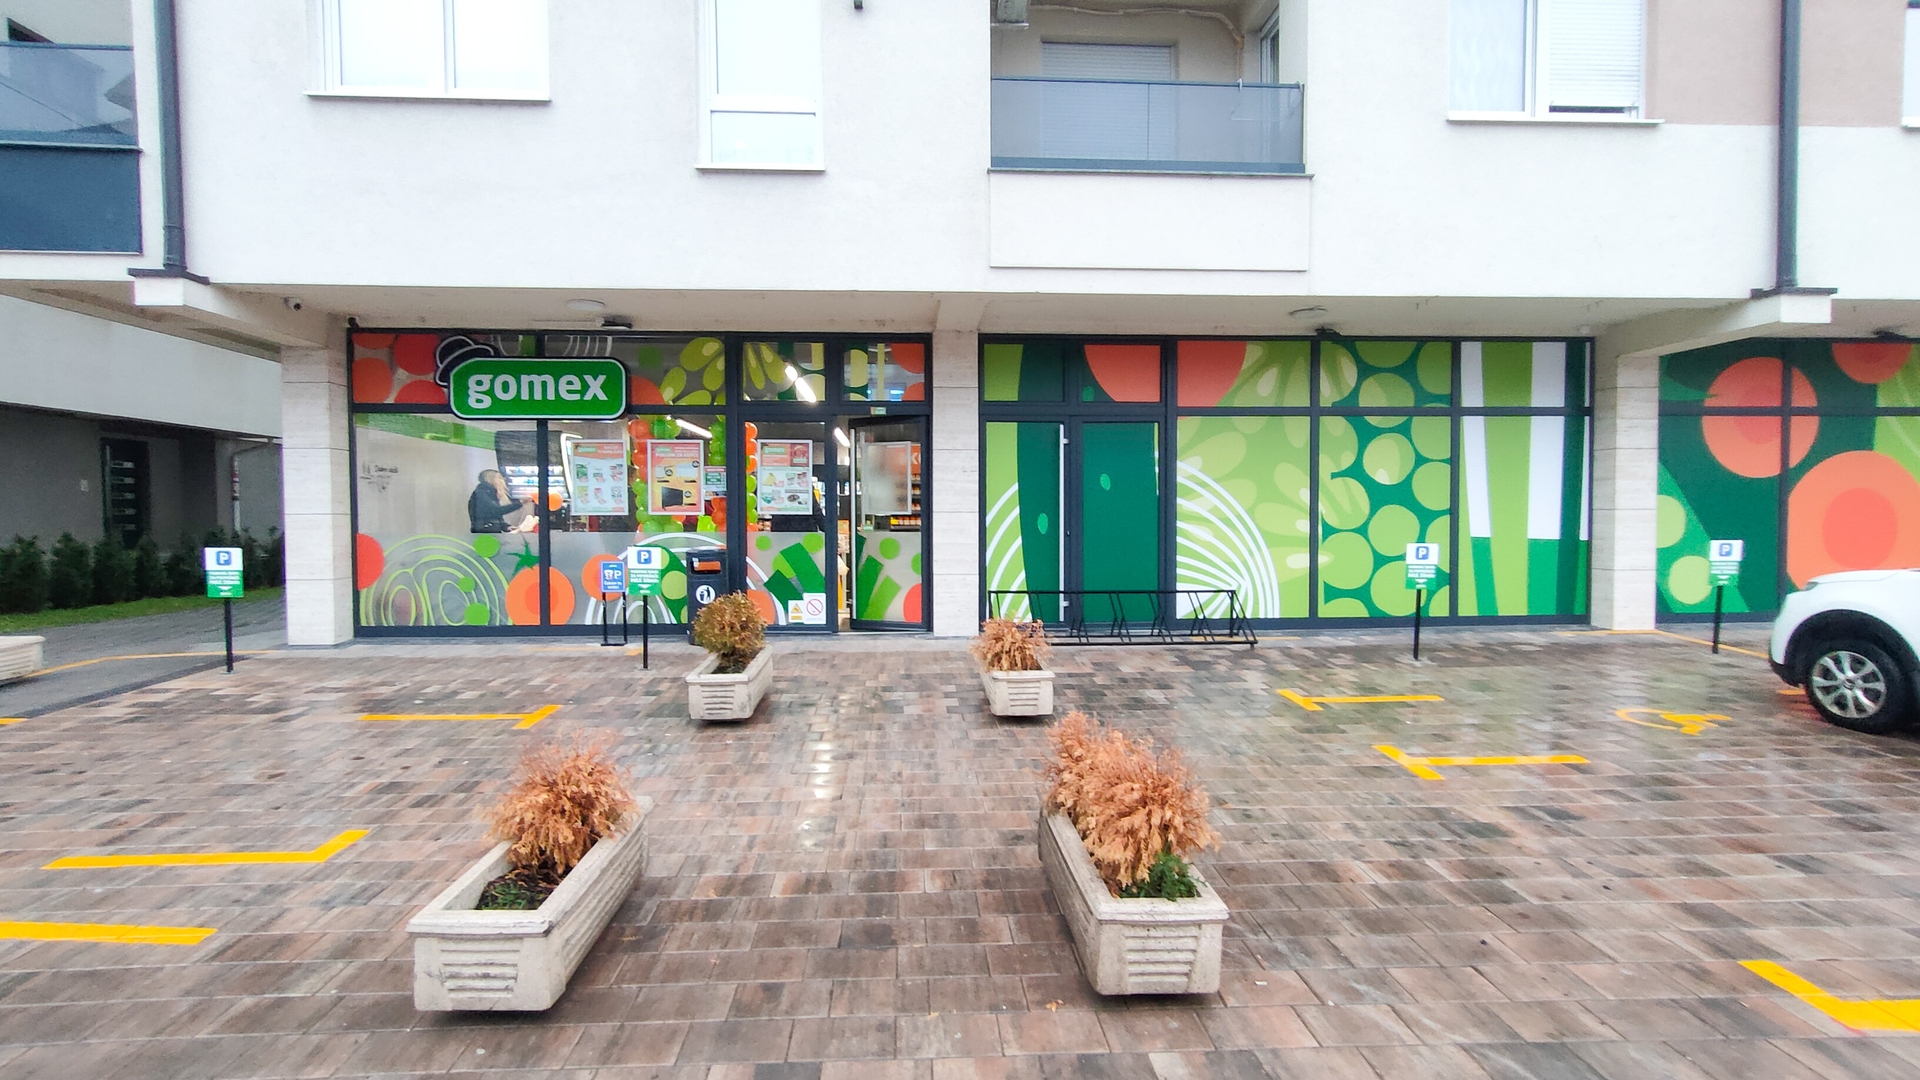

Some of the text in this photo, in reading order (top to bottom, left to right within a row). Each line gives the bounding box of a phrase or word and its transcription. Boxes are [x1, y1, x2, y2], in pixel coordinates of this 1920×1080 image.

[468, 374, 609, 409] gomex
[219, 552, 229, 564] P
[640, 551, 650, 563] P
[1418, 547, 1427, 559] P
